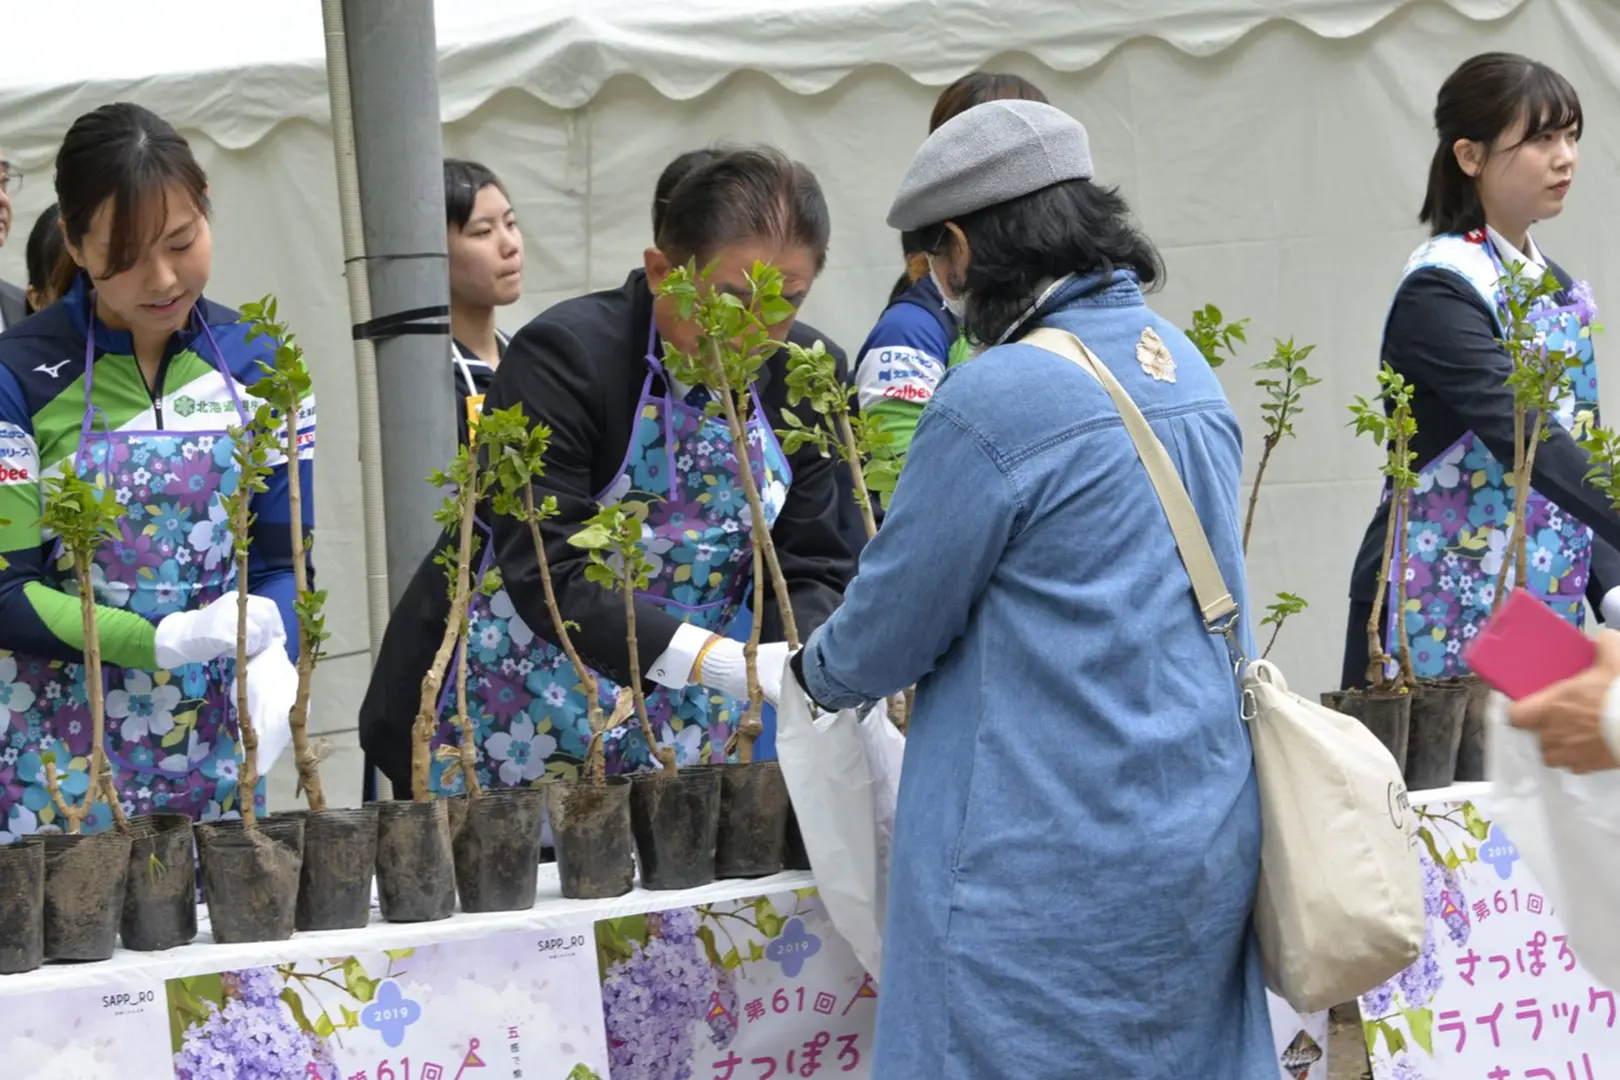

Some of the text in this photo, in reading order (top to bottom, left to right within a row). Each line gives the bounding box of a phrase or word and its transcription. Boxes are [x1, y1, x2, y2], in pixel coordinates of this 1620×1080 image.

[1488, 846, 1514, 858] 2019
[1472, 888, 1543, 922] 第61回
[777, 941, 809, 955] 2019
[374, 1006, 408, 1022] 2019
[744, 987, 837, 1024] 第61回
[1438, 986, 1616, 1053] ライラック
